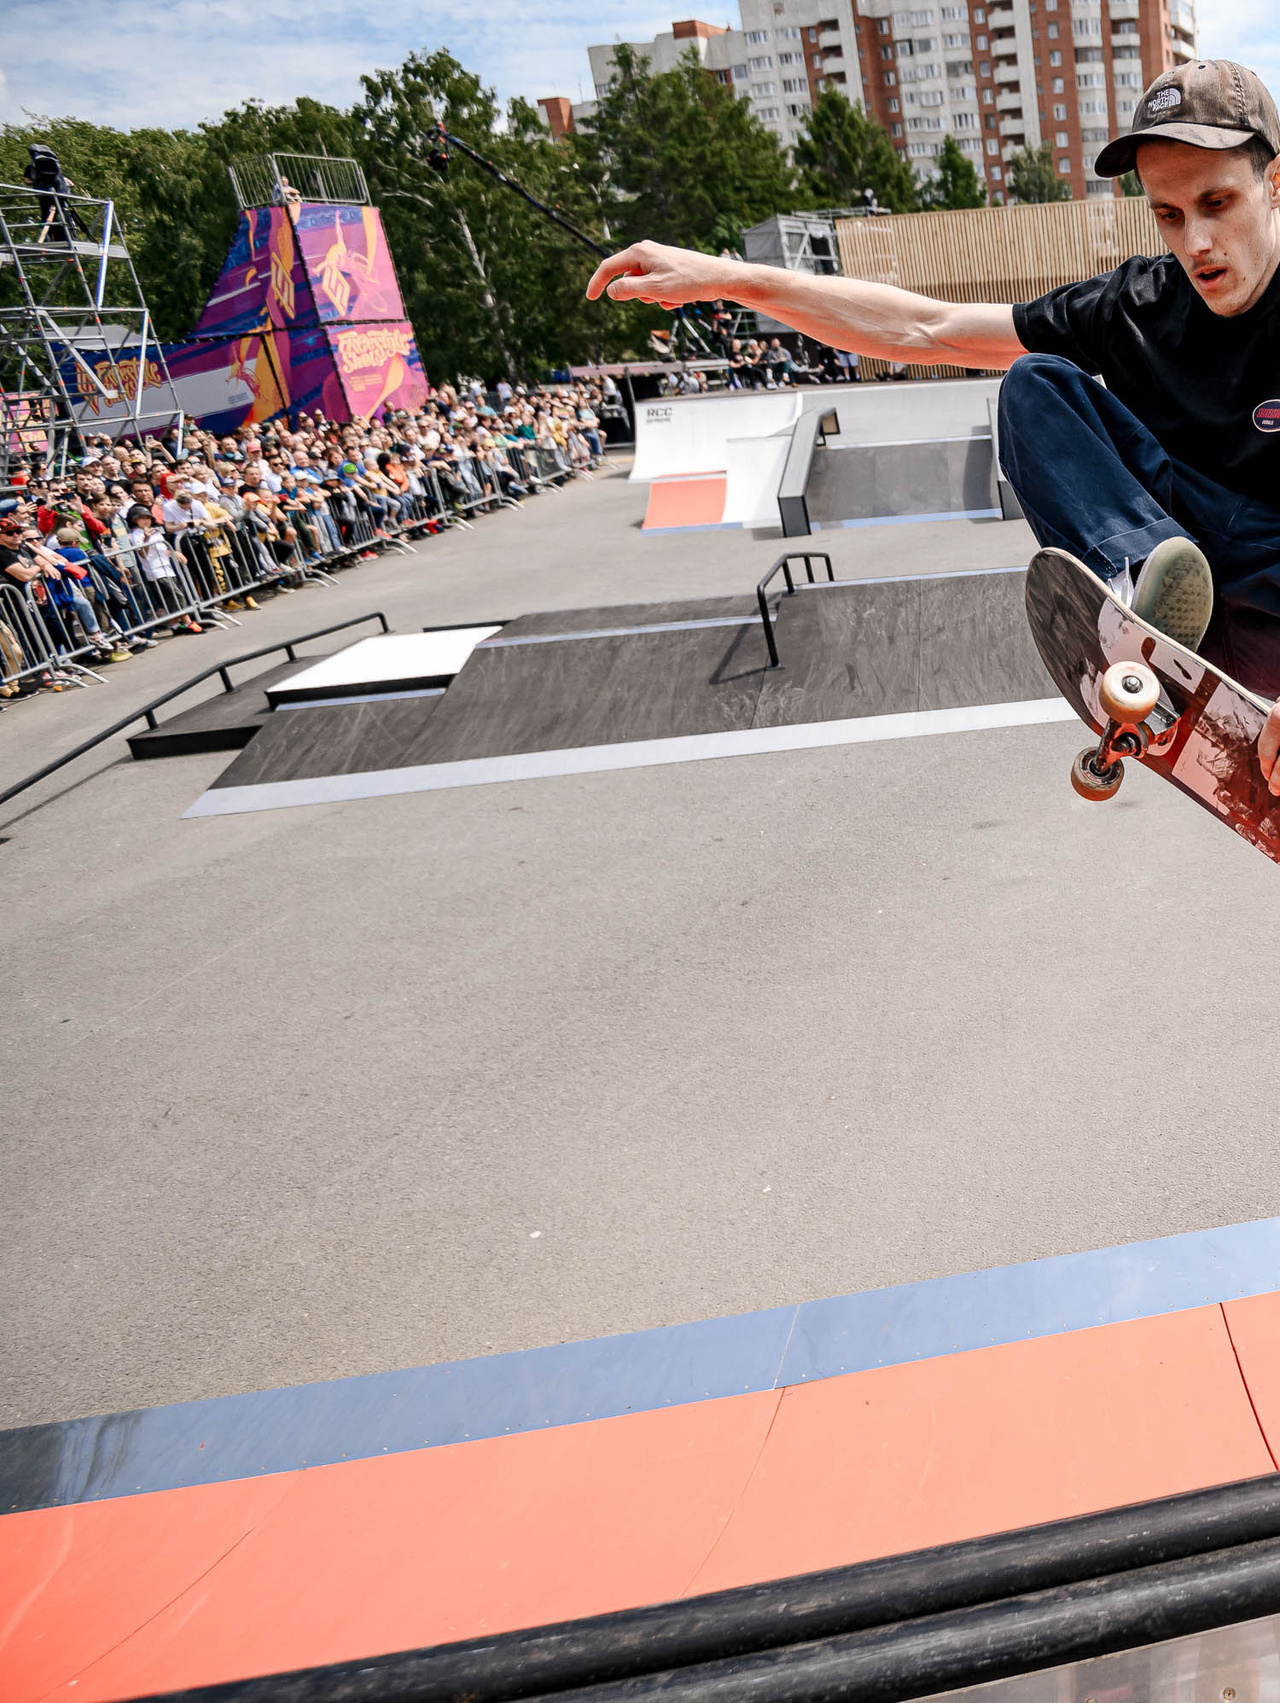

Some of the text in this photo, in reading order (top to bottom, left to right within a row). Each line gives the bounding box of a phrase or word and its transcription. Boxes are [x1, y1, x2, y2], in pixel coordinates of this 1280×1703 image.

[1157, 89, 1170, 98] THE
[1148, 95, 1170, 108] NORTH
[647, 407, 672, 418] RCC
